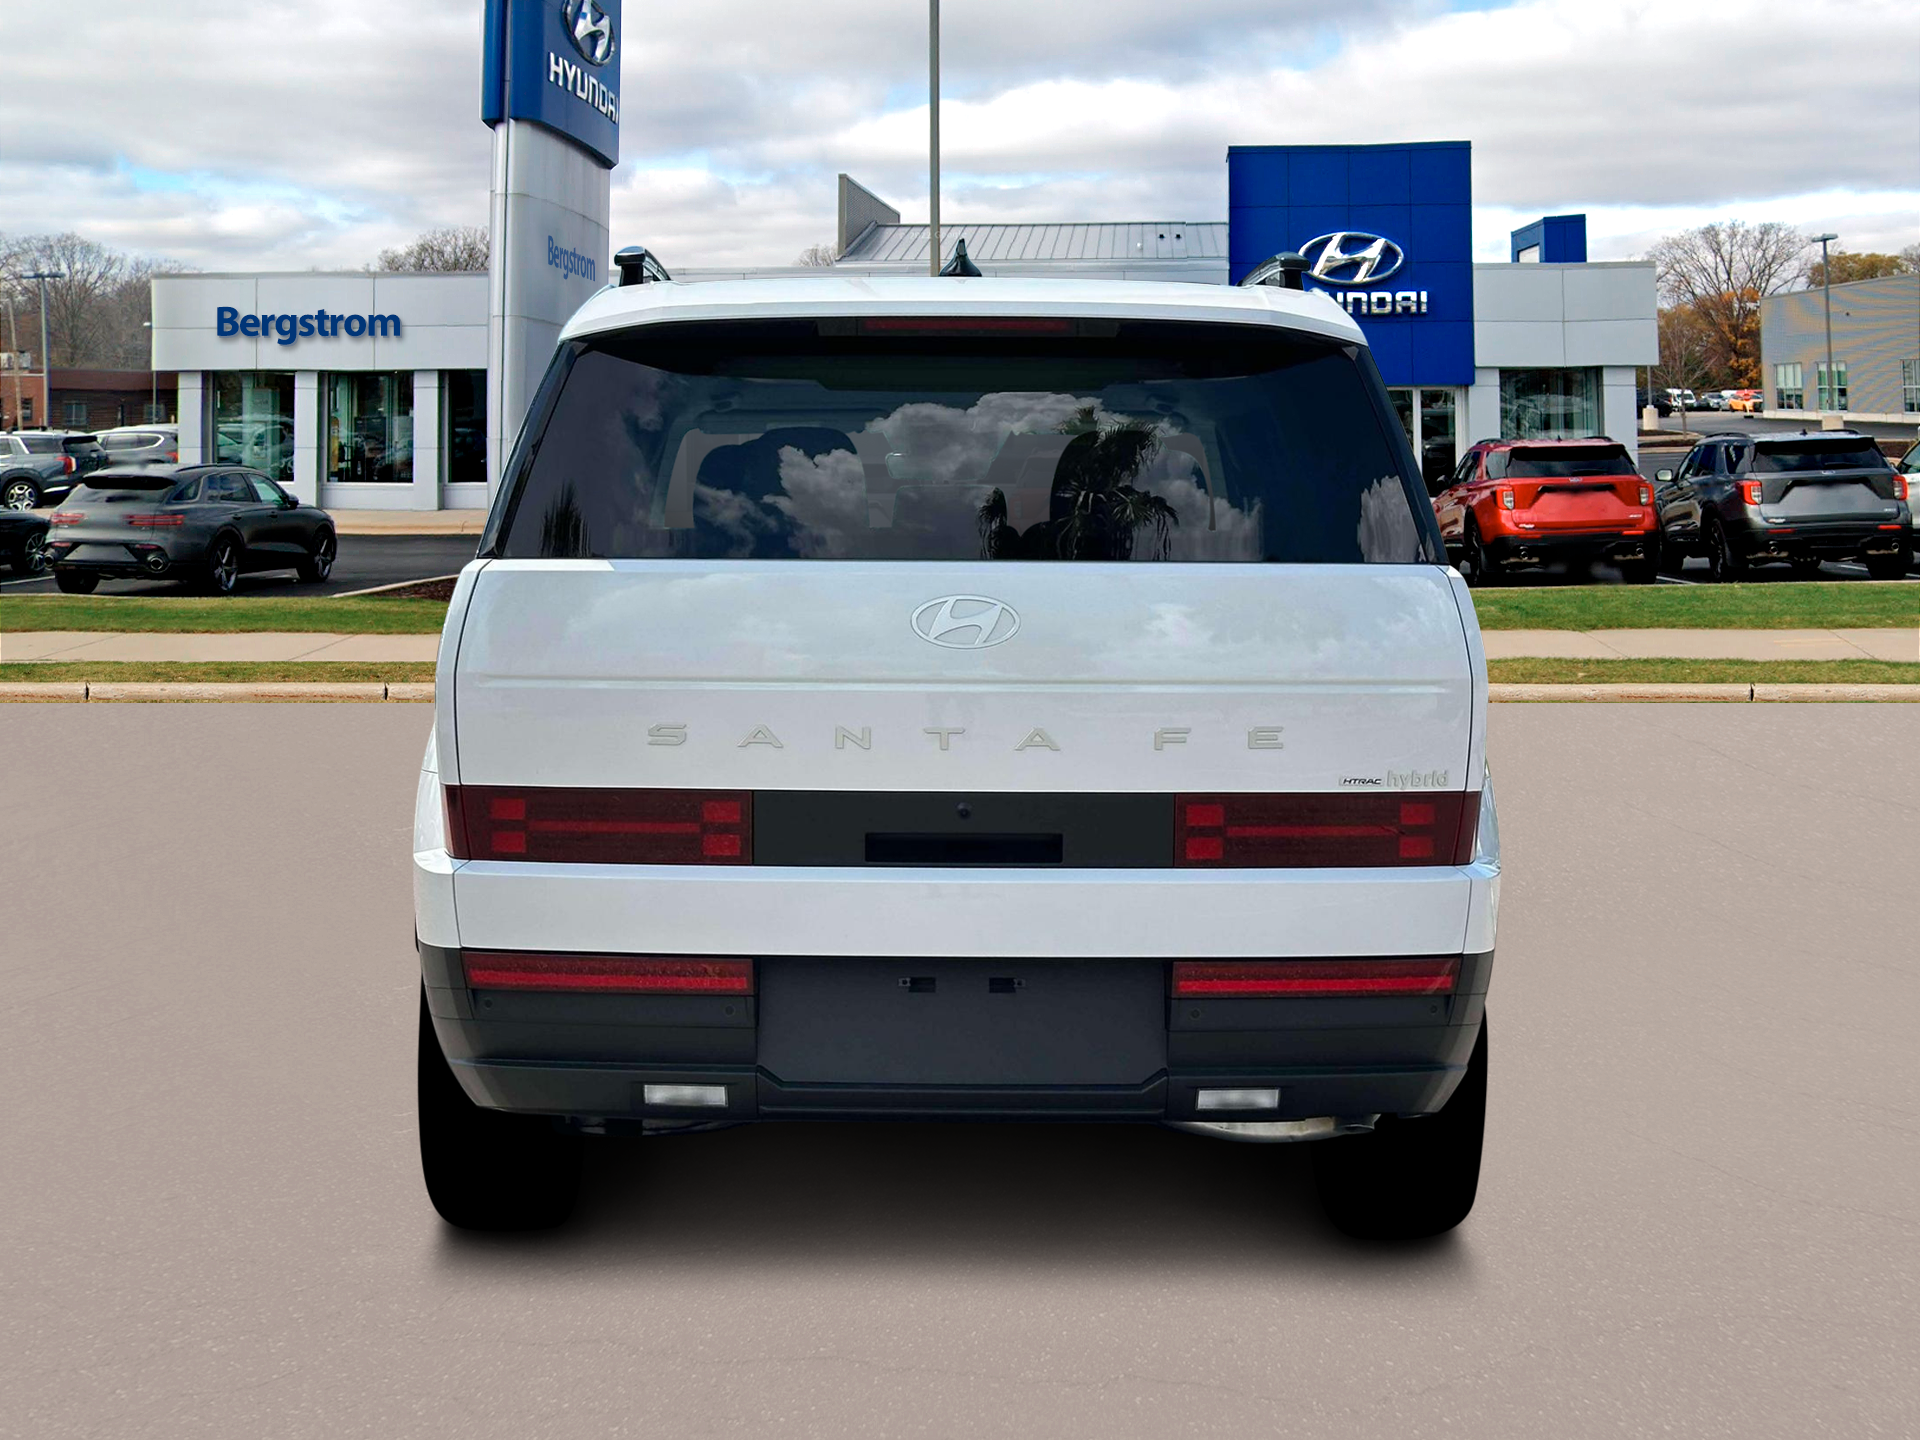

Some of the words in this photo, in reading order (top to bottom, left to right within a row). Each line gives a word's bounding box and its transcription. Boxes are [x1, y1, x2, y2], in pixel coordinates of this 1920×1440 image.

[549, 51, 619, 124] HYUNDAI
[547, 235, 596, 282] Bergstrom
[1328, 290, 1428, 314] NDAI
[216, 306, 402, 346] Bergstrom
[647, 723, 1061, 751] SANTA
[1153, 725, 1285, 751] FE
[1342, 777, 1383, 786] HTRAC
[1385, 769, 1449, 791] hybrid
